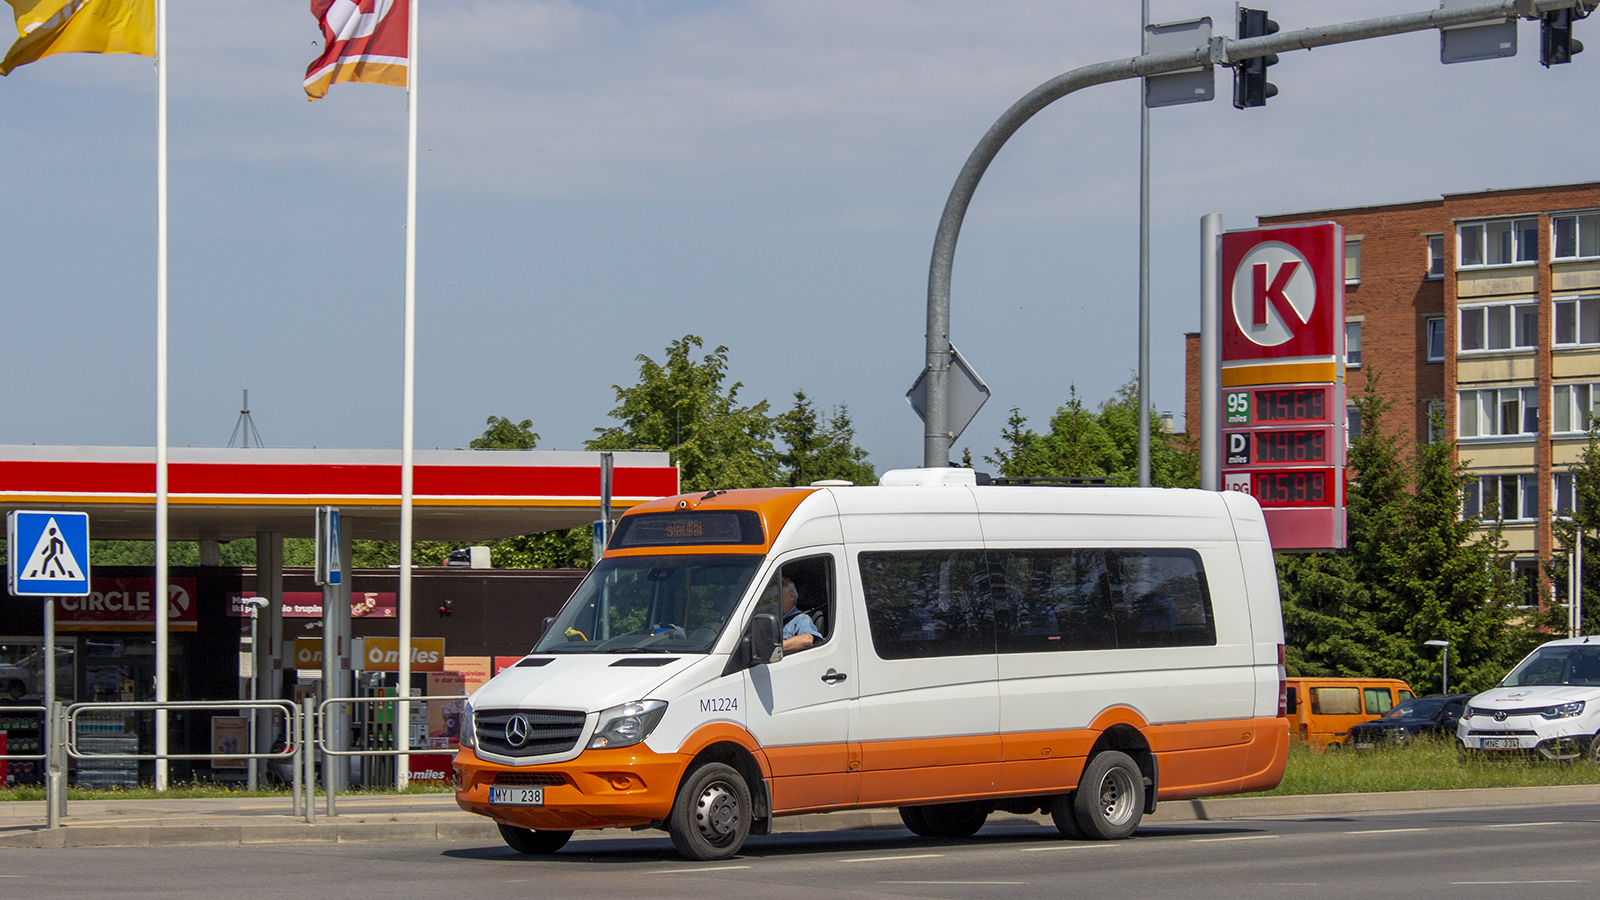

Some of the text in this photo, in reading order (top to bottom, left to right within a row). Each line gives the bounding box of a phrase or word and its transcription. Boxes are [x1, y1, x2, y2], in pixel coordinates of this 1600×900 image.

[1251, 258, 1308, 340] K
[1227, 393, 1249, 413] 95
[1228, 415, 1248, 423] miles
[1230, 434, 1247, 453] D
[1228, 454, 1248, 463] miles
[61, 591, 150, 611] CIRCLE
[384, 647, 439, 663] mles
[700, 697, 738, 712] M1224
[413, 769, 445, 779] miles
[495, 789, 541, 802] MYI 238
